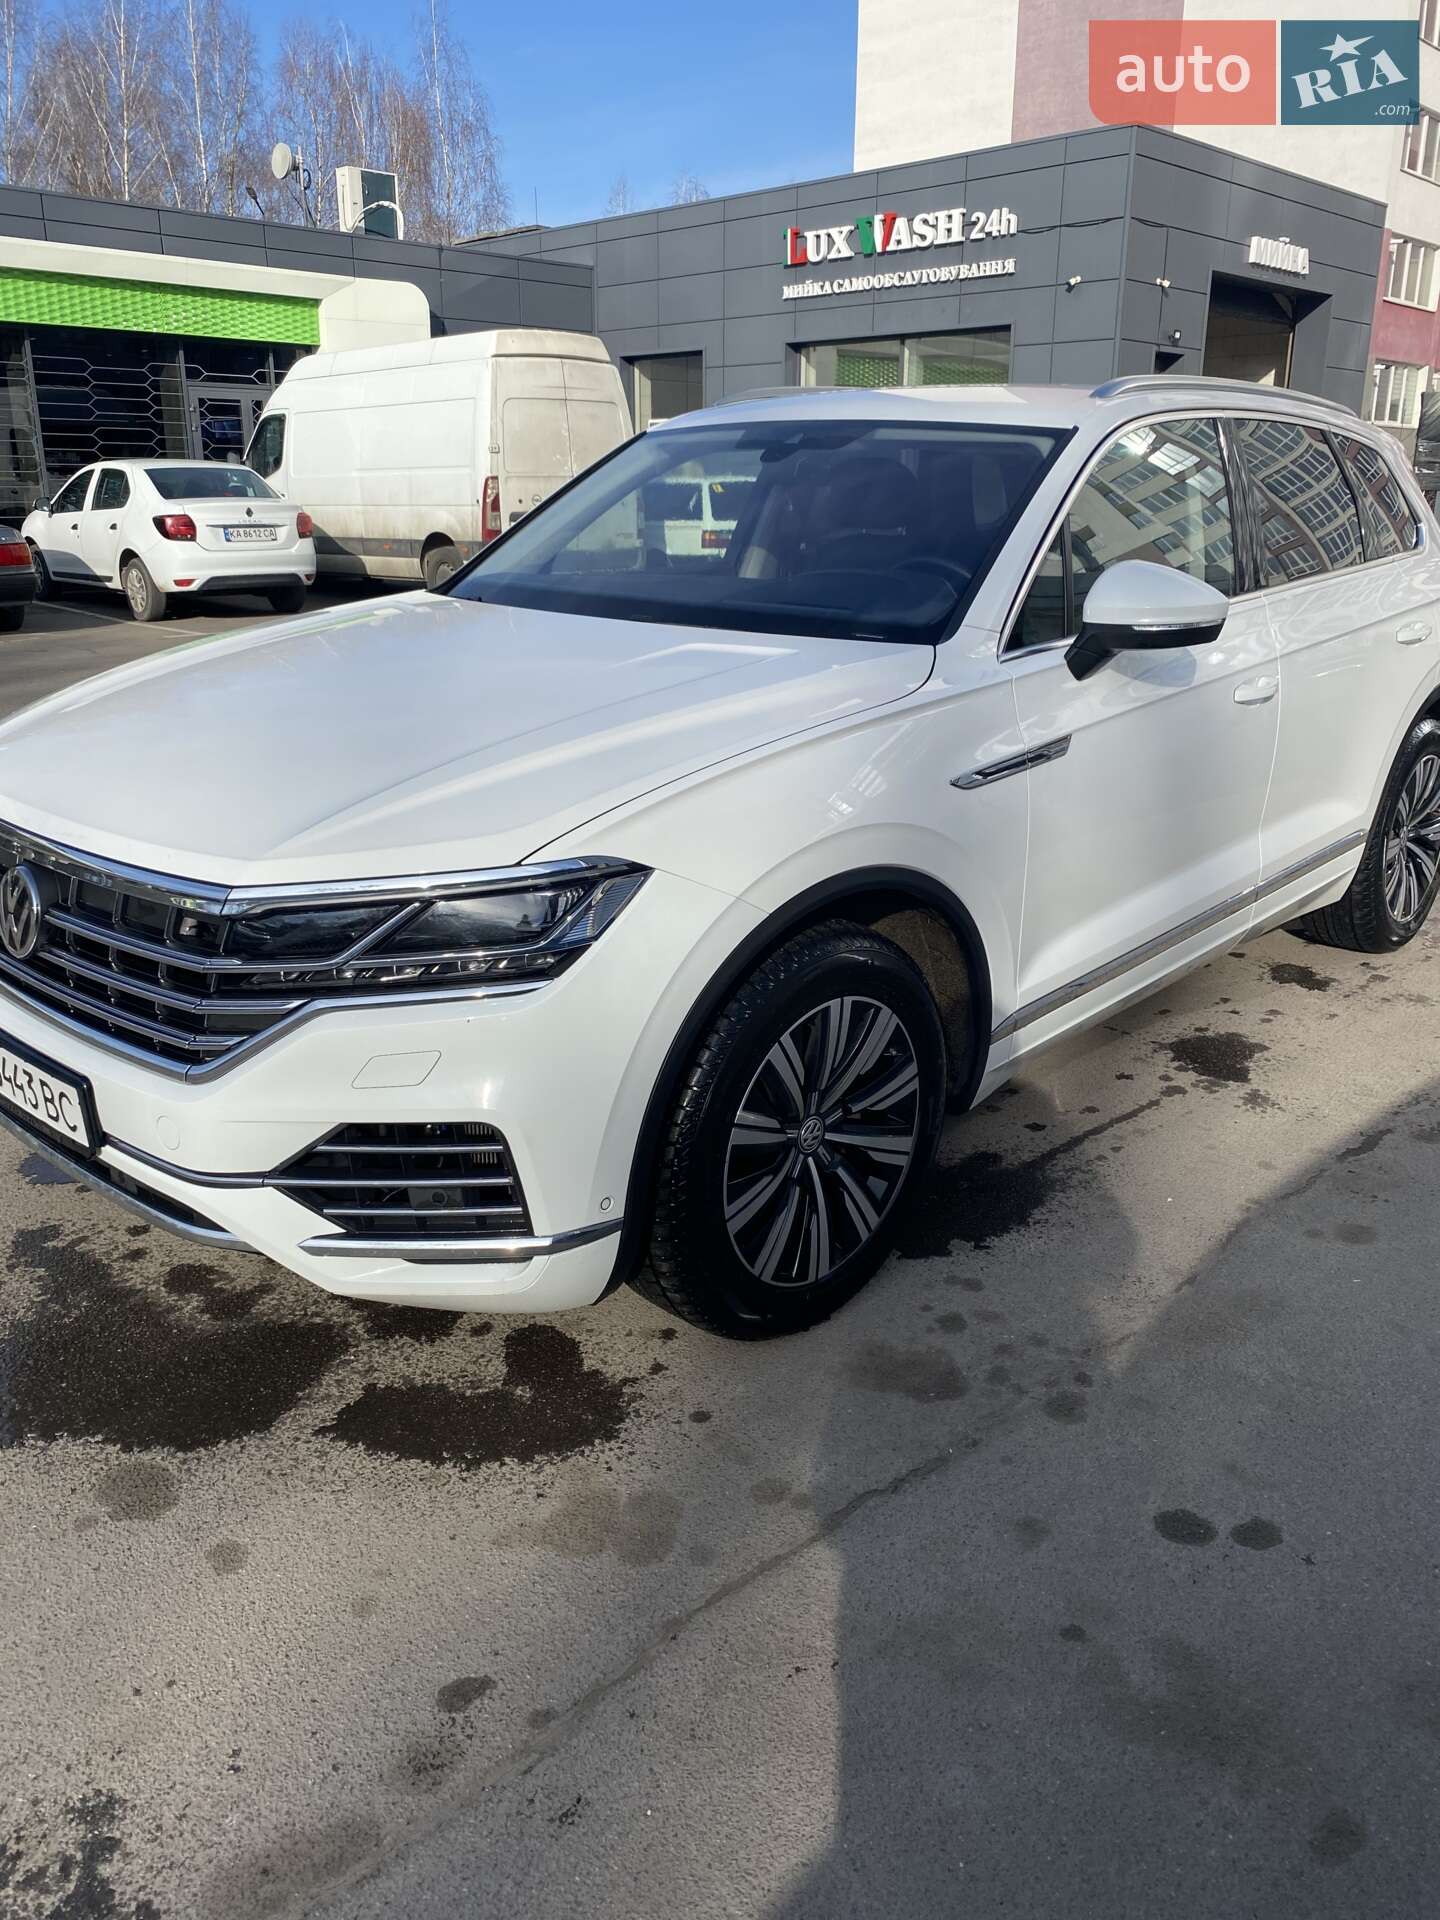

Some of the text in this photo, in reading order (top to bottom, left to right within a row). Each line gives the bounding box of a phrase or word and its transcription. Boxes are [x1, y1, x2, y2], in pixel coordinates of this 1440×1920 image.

[784, 207, 1018, 266] LUX WASH 24h
[782, 258, 1017, 300] МИЙКА САМООБСЛУГОВУВАННЯ
[0, 1057, 39, 1110] 443
